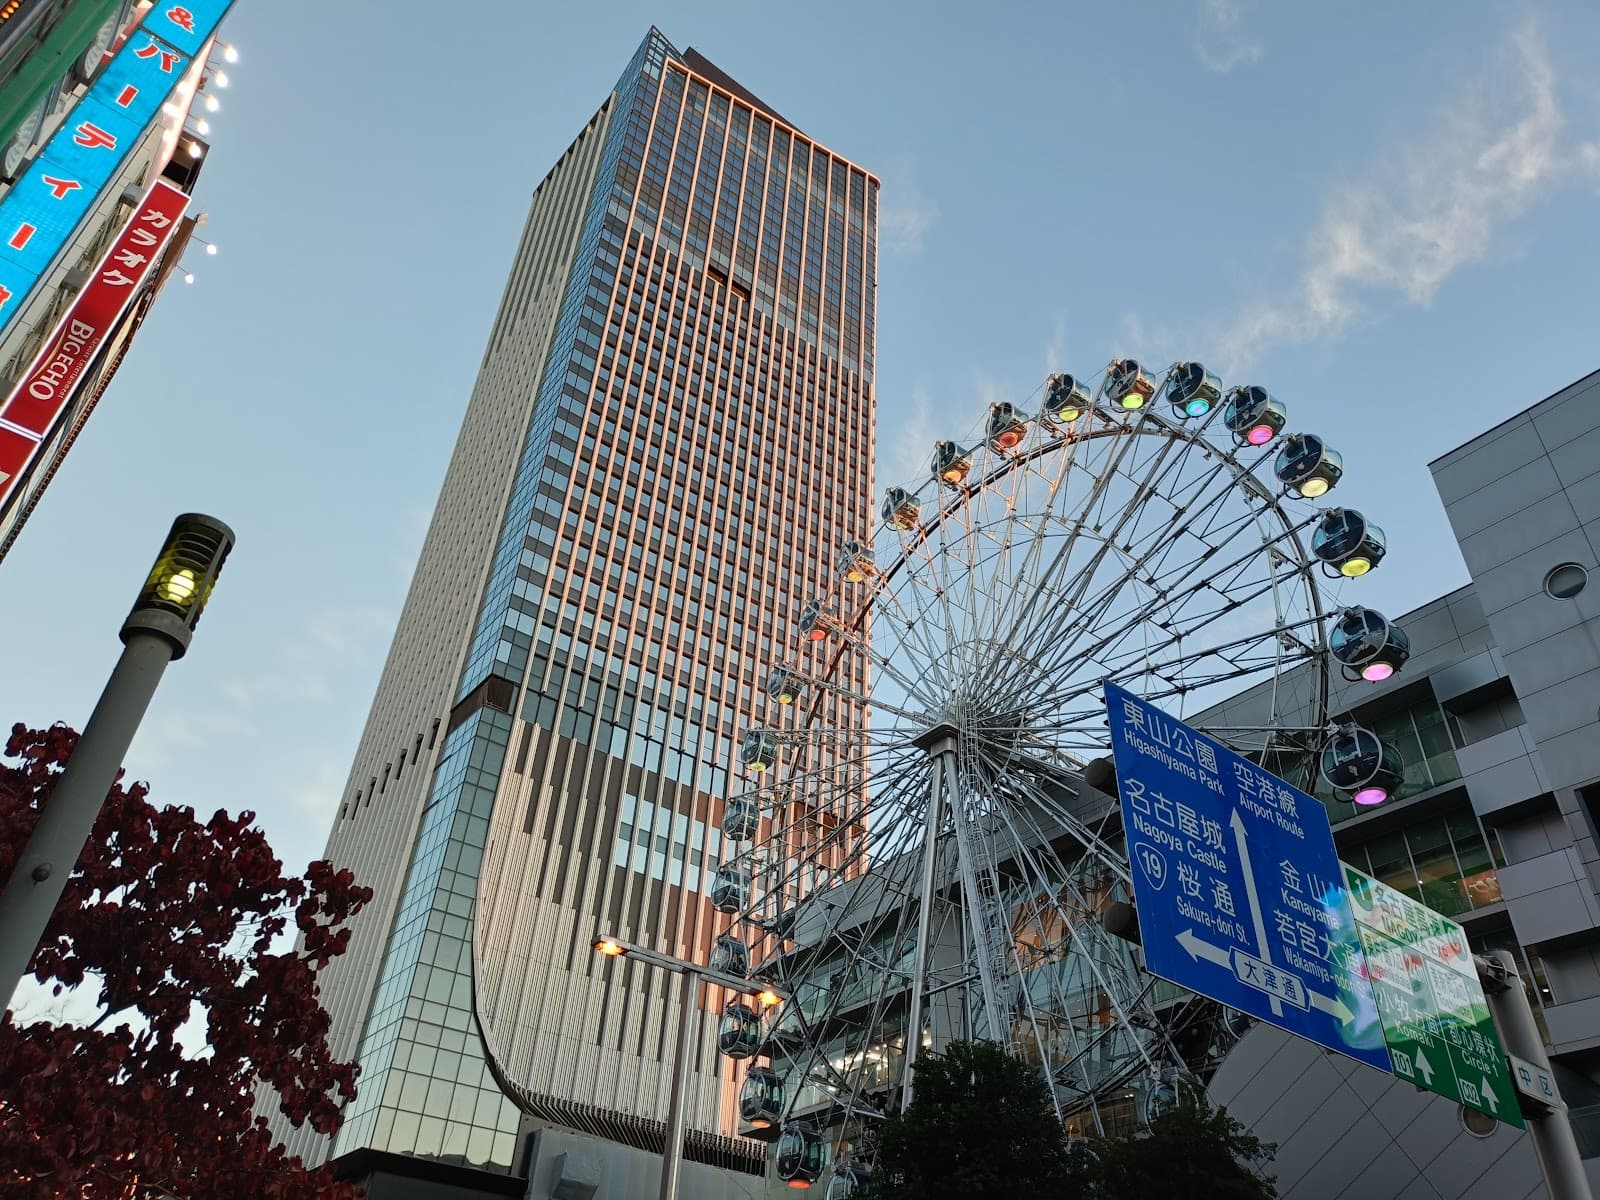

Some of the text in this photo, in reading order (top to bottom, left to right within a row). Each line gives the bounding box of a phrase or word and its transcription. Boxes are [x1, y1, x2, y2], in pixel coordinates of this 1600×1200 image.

[0, 7, 195, 308] &パーティー
[103, 208, 171, 286] カラオケ
[28, 318, 96, 401] BIG ECHO
[1121, 697, 1218, 774] 東山公園
[1124, 731, 1224, 796] Higashiyama Park
[1232, 761, 1299, 819] 空港線
[1124, 778, 1226, 854] 名古屋城
[1239, 794, 1305, 839] Airport Route
[1133, 814, 1227, 874] Nagoya Castle
[1142, 850, 1162, 879] 19
[1176, 860, 1236, 917] 桜通
[1279, 859, 1329, 906] 金山
[1354, 878, 1365, 900] 1
[1176, 897, 1250, 945] Sakura-dori St.
[1281, 888, 1340, 929] Kanayama
[1274, 908, 1362, 977] 若宮大通
[1383, 916, 1427, 950] NAGOYA
[1244, 960, 1297, 999] 大津通
[1396, 1021, 1435, 1048] Komaki
[1448, 1020, 1500, 1063] 都心環状
[1393, 1052, 1413, 1075] 101
[1461, 1049, 1499, 1077] Circle 1
[1519, 1066, 1552, 1097] 中区
